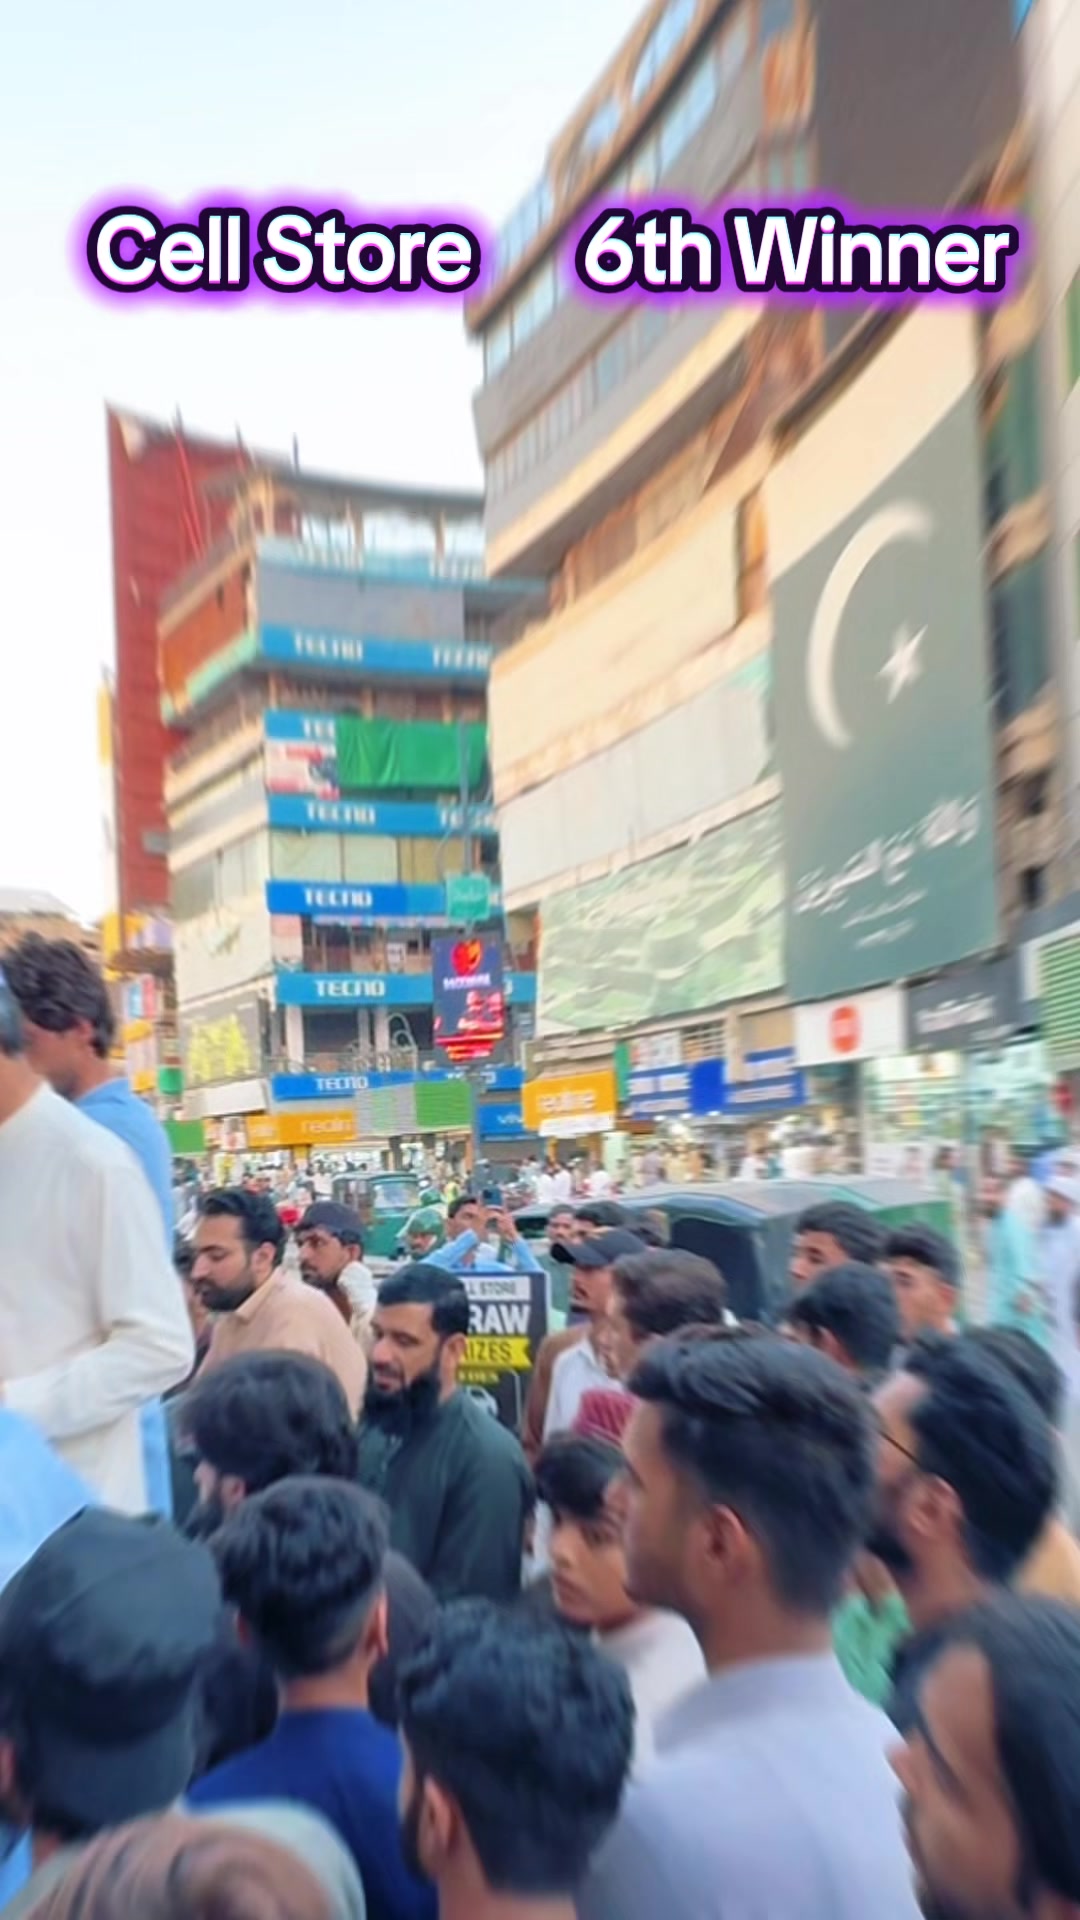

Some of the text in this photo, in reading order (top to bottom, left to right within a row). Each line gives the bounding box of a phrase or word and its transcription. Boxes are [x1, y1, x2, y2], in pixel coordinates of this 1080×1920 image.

[307, 802, 377, 826] TECNO
[304, 887, 374, 908] TECNO
[314, 979, 386, 998] TECNO
[314, 1075, 369, 1092] TECNO
[479, 1281, 516, 1297] STORE
[468, 1303, 530, 1335] RAW
[464, 1341, 512, 1362] IZES
